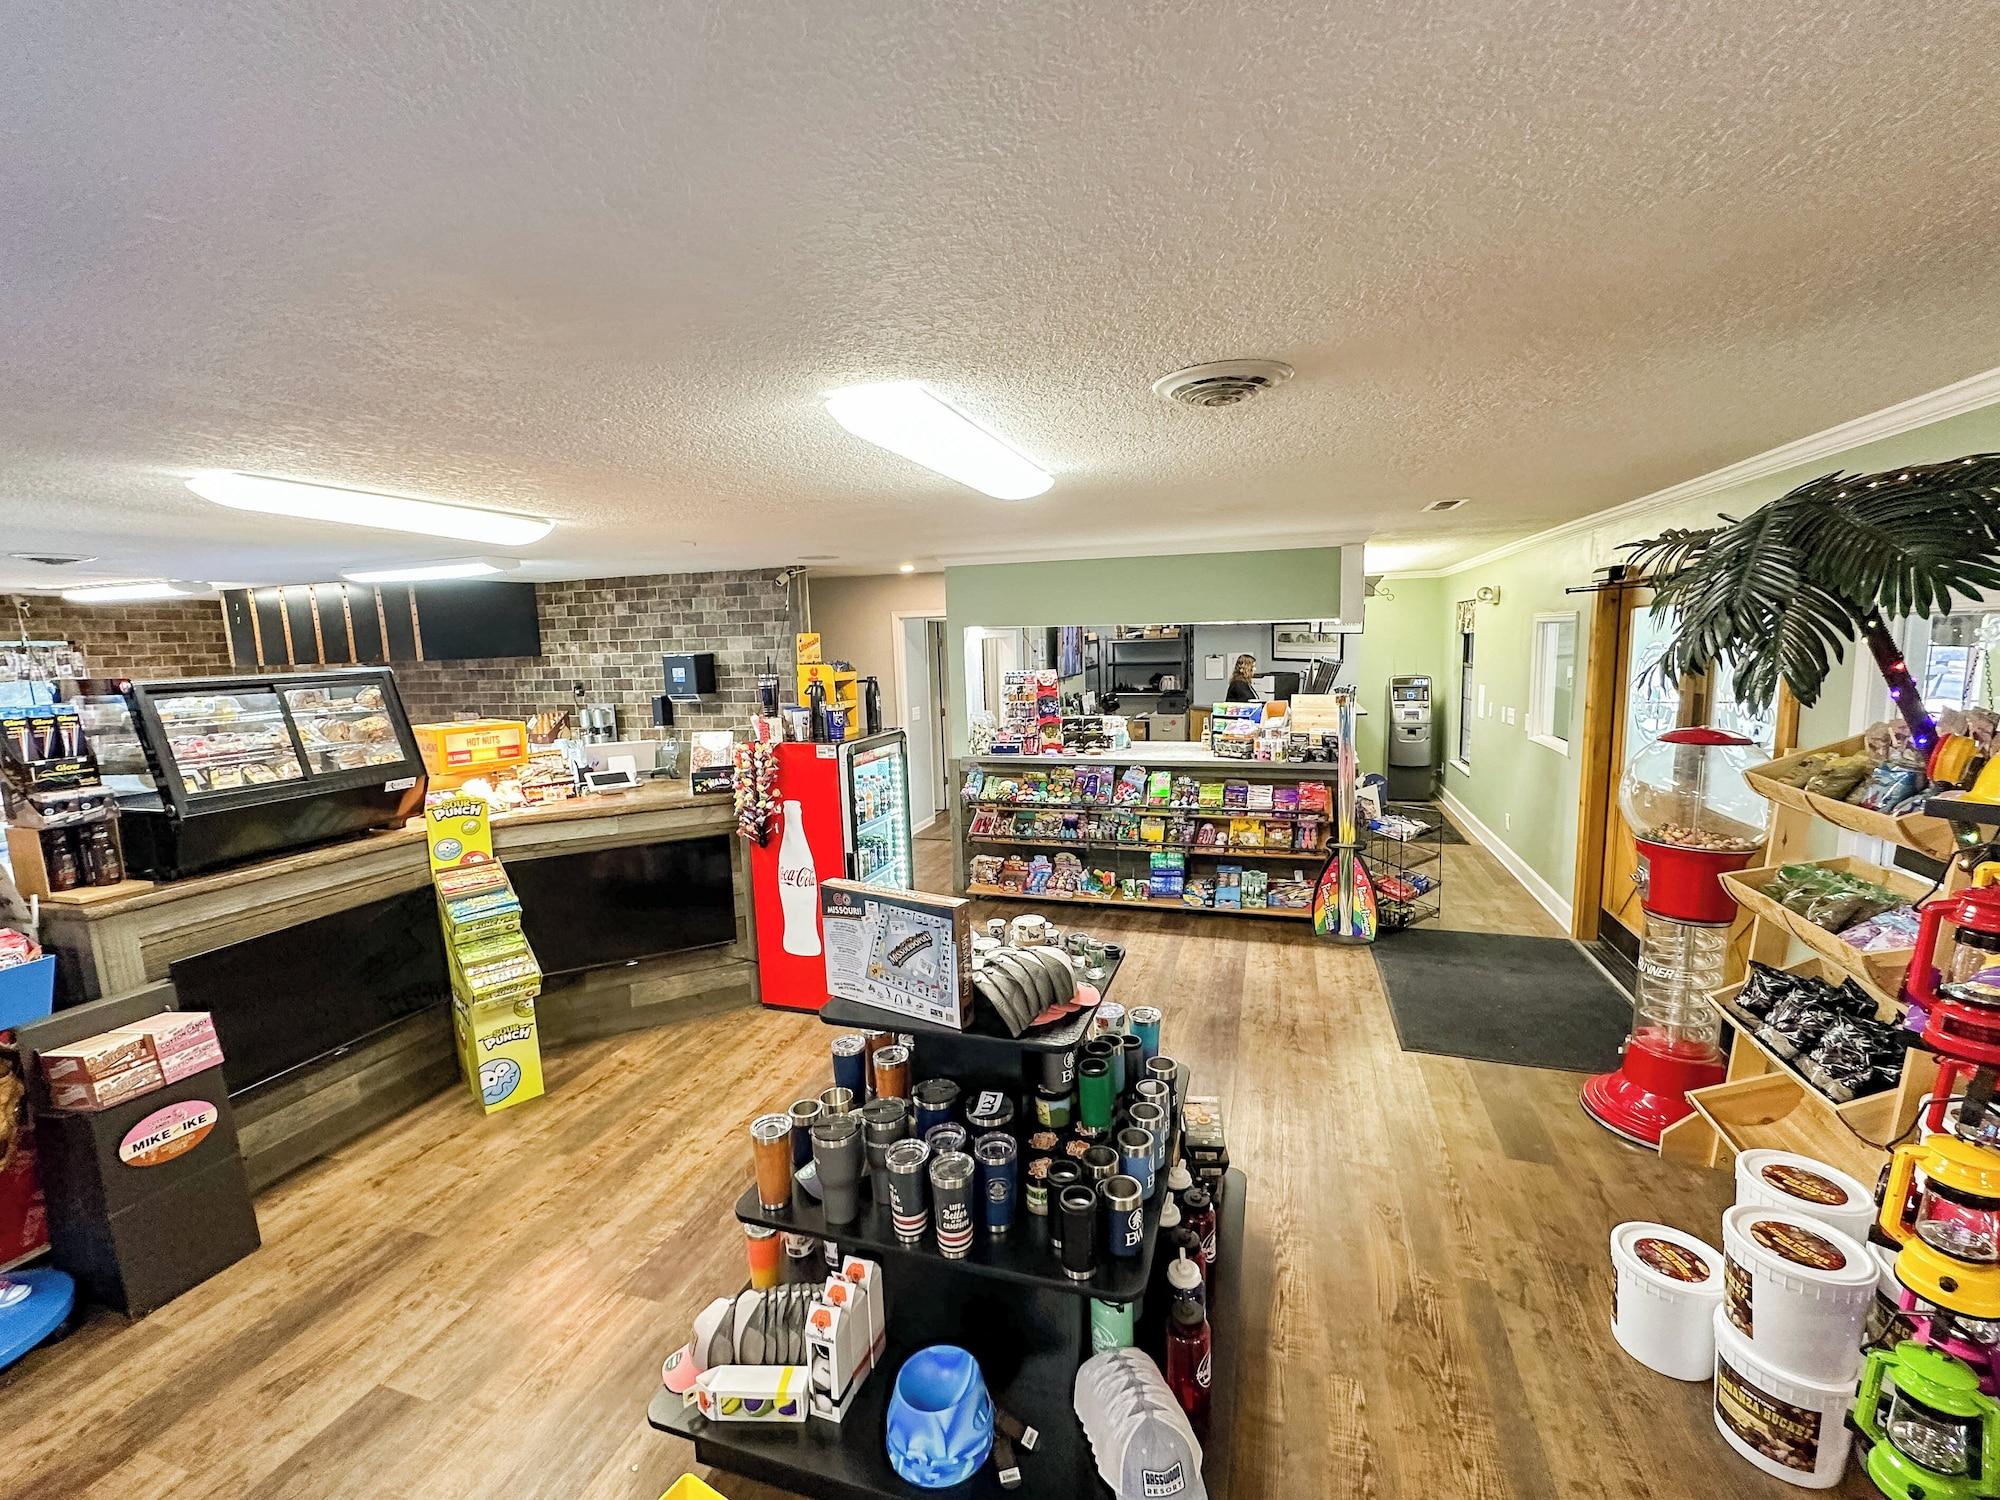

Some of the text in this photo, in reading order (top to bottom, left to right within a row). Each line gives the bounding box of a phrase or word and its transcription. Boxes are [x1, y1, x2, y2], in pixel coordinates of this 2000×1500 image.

[1413, 678, 1428, 686] ATM
[3, 719, 26, 727] Glow
[32, 719, 54, 727] Glow
[466, 735, 501, 747] HOT NUTS
[55, 763, 80, 772] Glow
[442, 799, 470, 809] SOUR
[432, 804, 482, 822] PUNCH
[1638, 955, 1675, 980] RUNNER
[160, 1019, 208, 1049] COTTON CANDY
[492, 1023, 519, 1037] SOUR
[483, 1026, 532, 1051] PUNCH
[132, 1129, 171, 1153] MIKE
[182, 1113, 207, 1130] IKE
[942, 1208, 967, 1220] Better
[1763, 1407, 1815, 1439] BUCKET
[1145, 1465, 1180, 1485] BASSWOOD
[1147, 1481, 1183, 1494] RESORT
